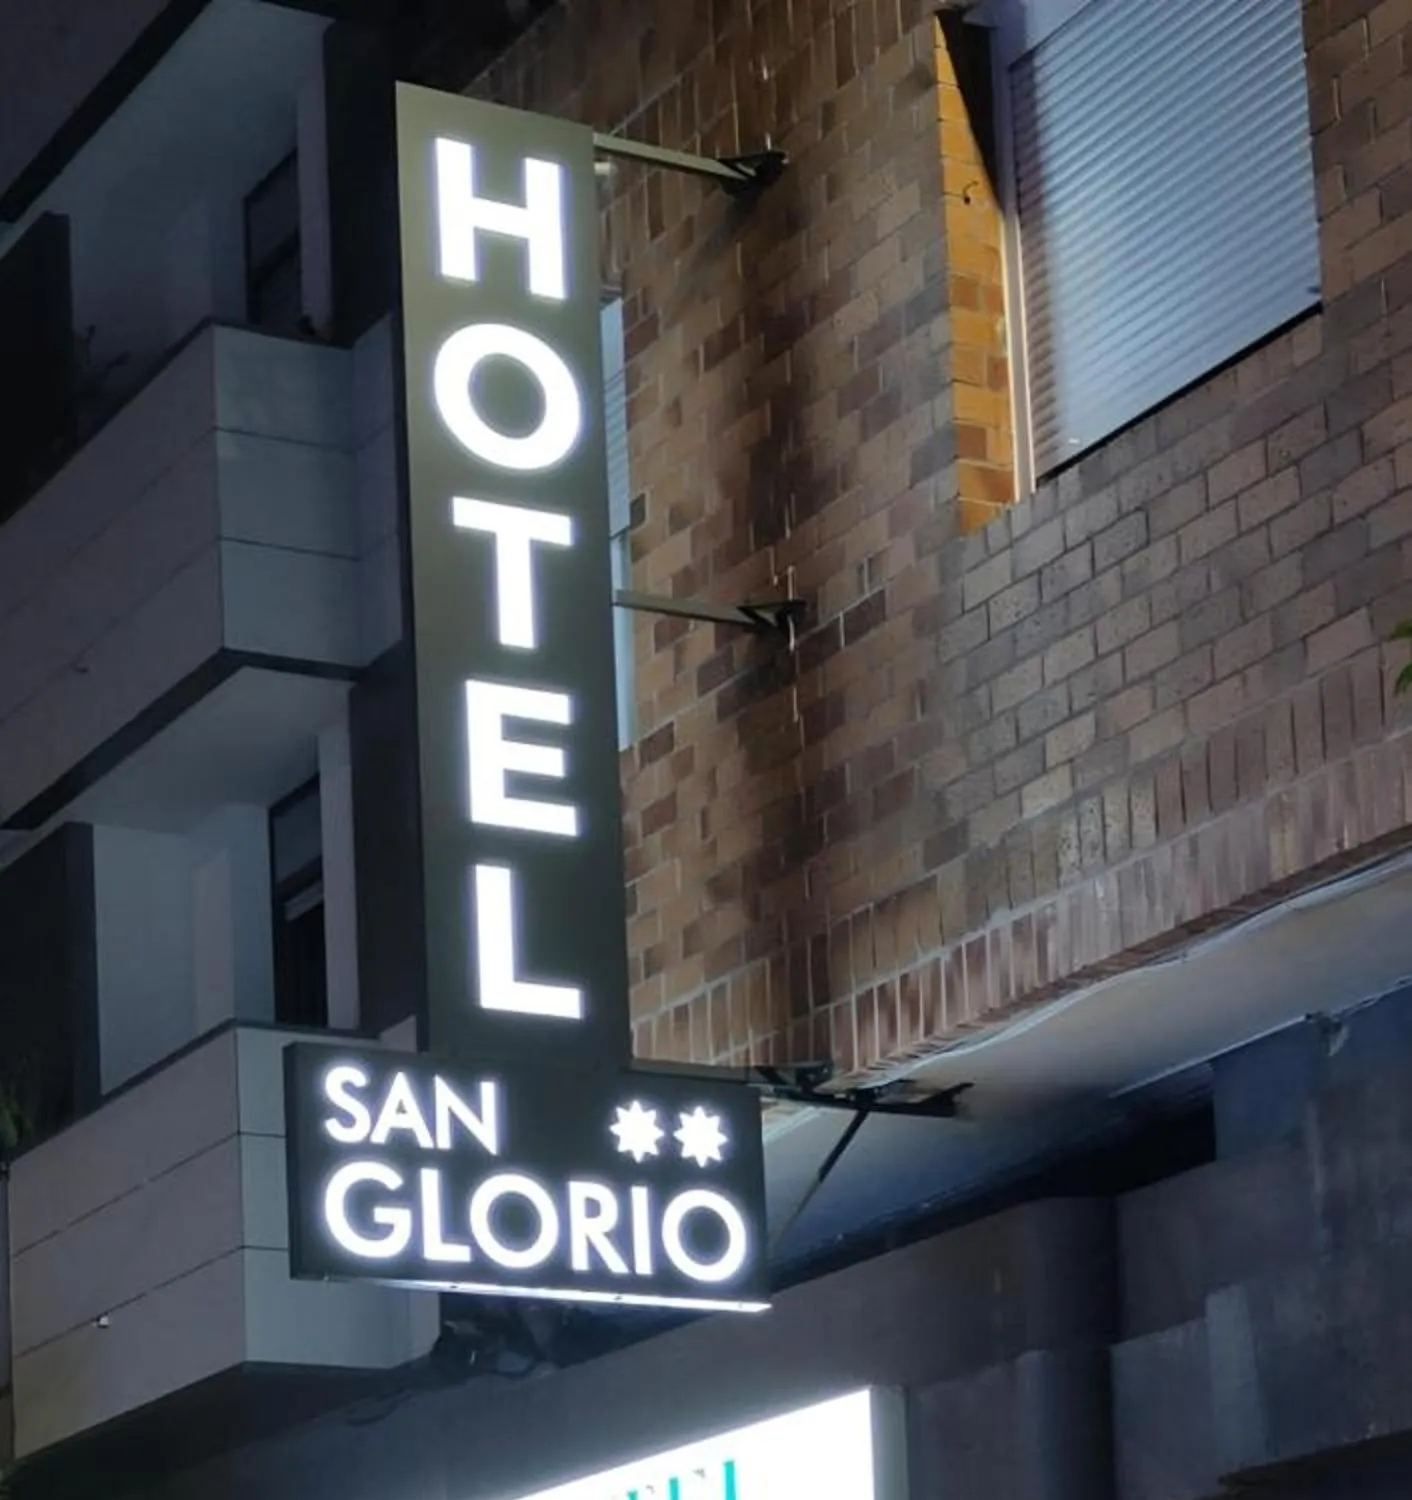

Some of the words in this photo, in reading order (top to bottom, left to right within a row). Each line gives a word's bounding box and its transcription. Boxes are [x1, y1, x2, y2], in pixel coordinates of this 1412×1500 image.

[433, 136, 585, 1020] HOTEL
[323, 1066, 498, 1156] SAN
[323, 1161, 748, 1283] GLORIO
